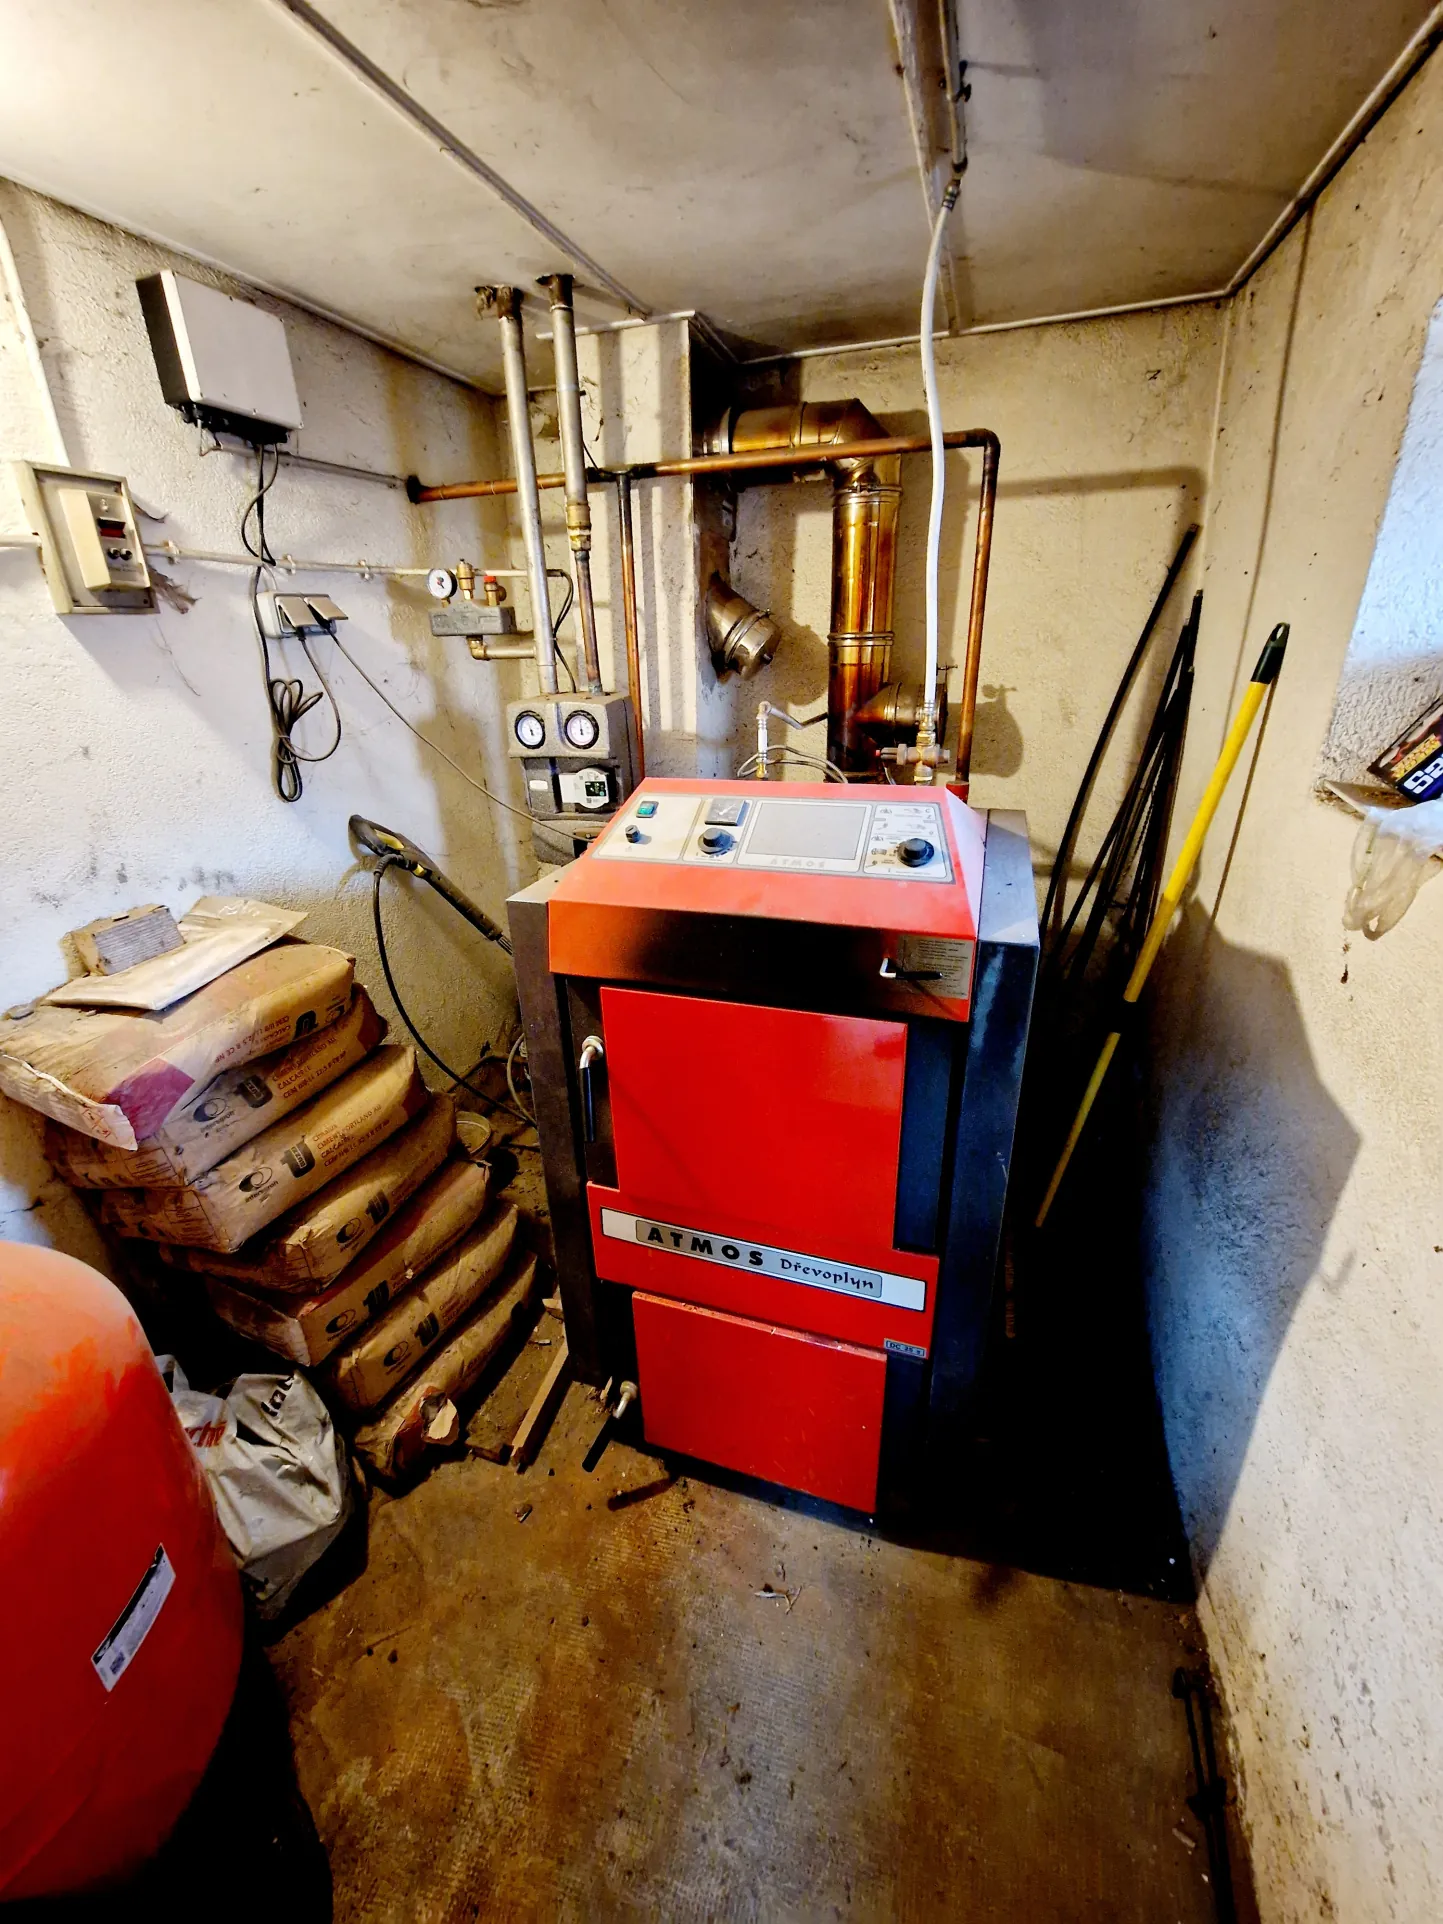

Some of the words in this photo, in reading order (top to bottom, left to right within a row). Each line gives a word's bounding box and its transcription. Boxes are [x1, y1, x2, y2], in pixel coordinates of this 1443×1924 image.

[770, 857, 826, 869] ATMOS
[647, 1226, 764, 1267] ATMOS
[780, 1257, 875, 1291] Dřevoplyn
